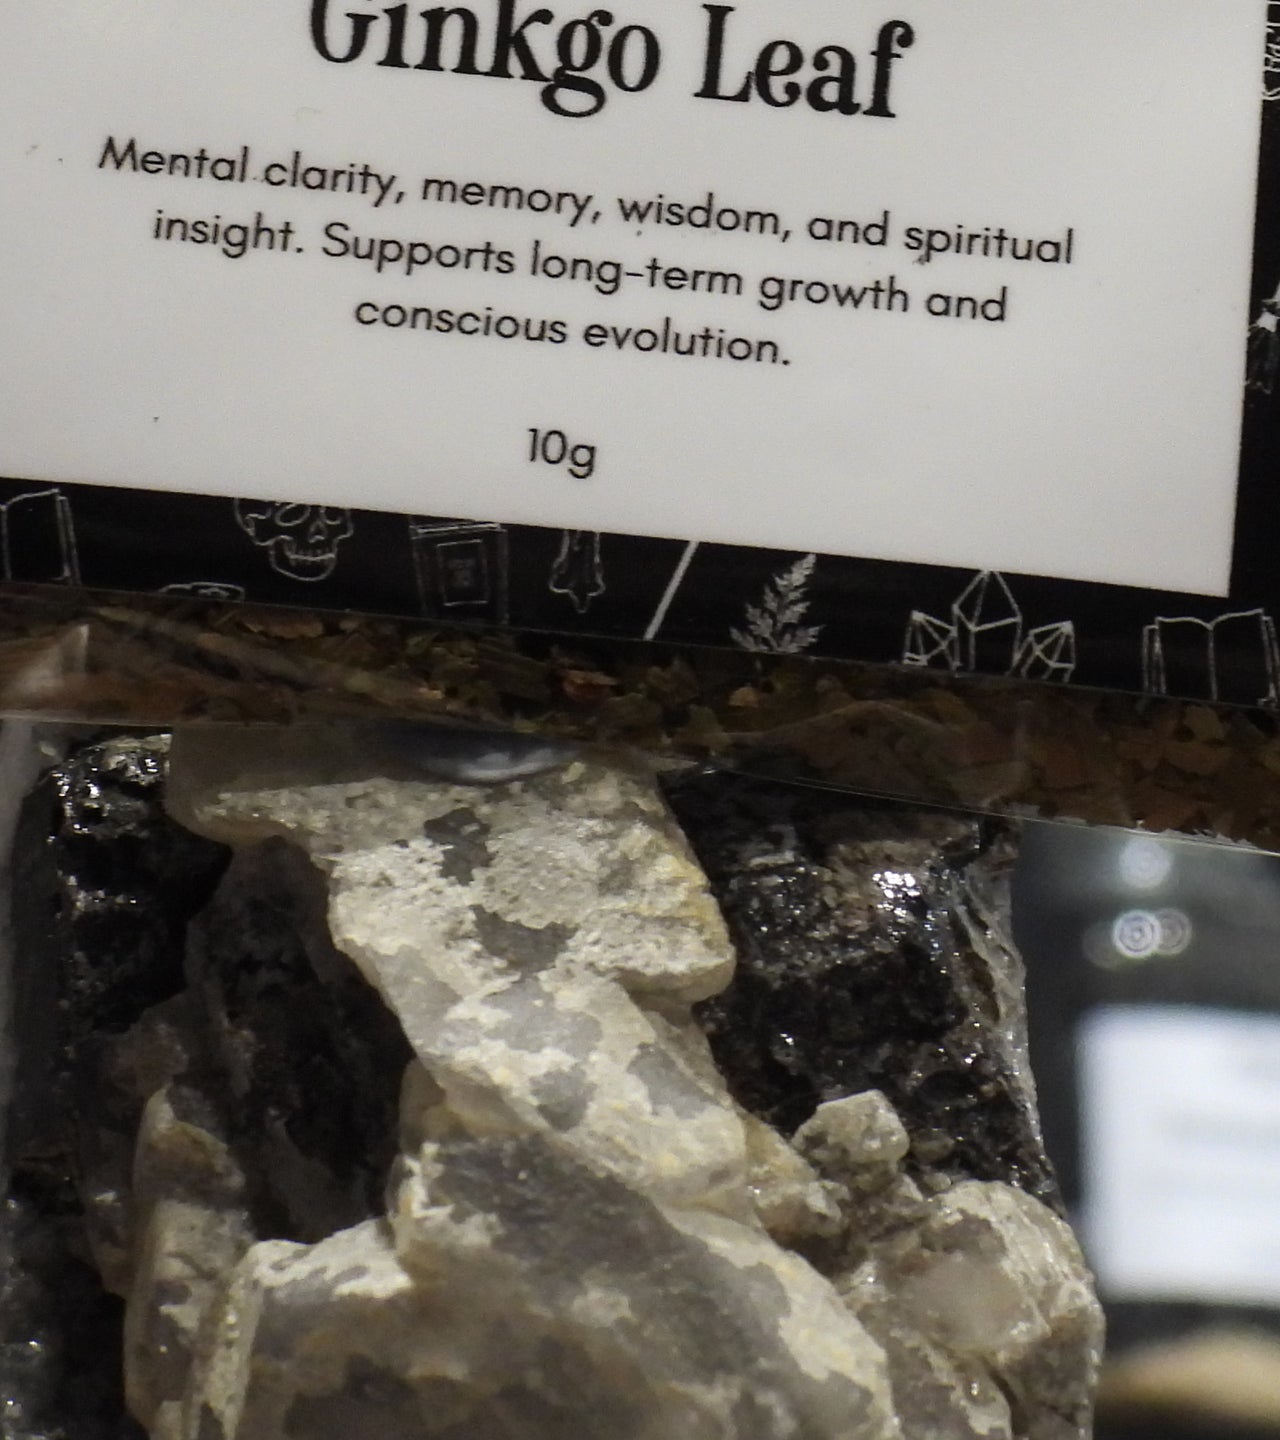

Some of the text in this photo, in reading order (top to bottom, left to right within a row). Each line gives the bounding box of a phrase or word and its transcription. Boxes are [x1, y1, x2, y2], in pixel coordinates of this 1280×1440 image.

[693, 3, 915, 119] Leaf
[97, 135, 1074, 266] Mental clarity, memory, wisdom, and spiritual
[153, 209, 1008, 322] insight. Supports long-term growth and
[354, 301, 791, 366] conscious evolution.
[528, 427, 597, 480] 10g
